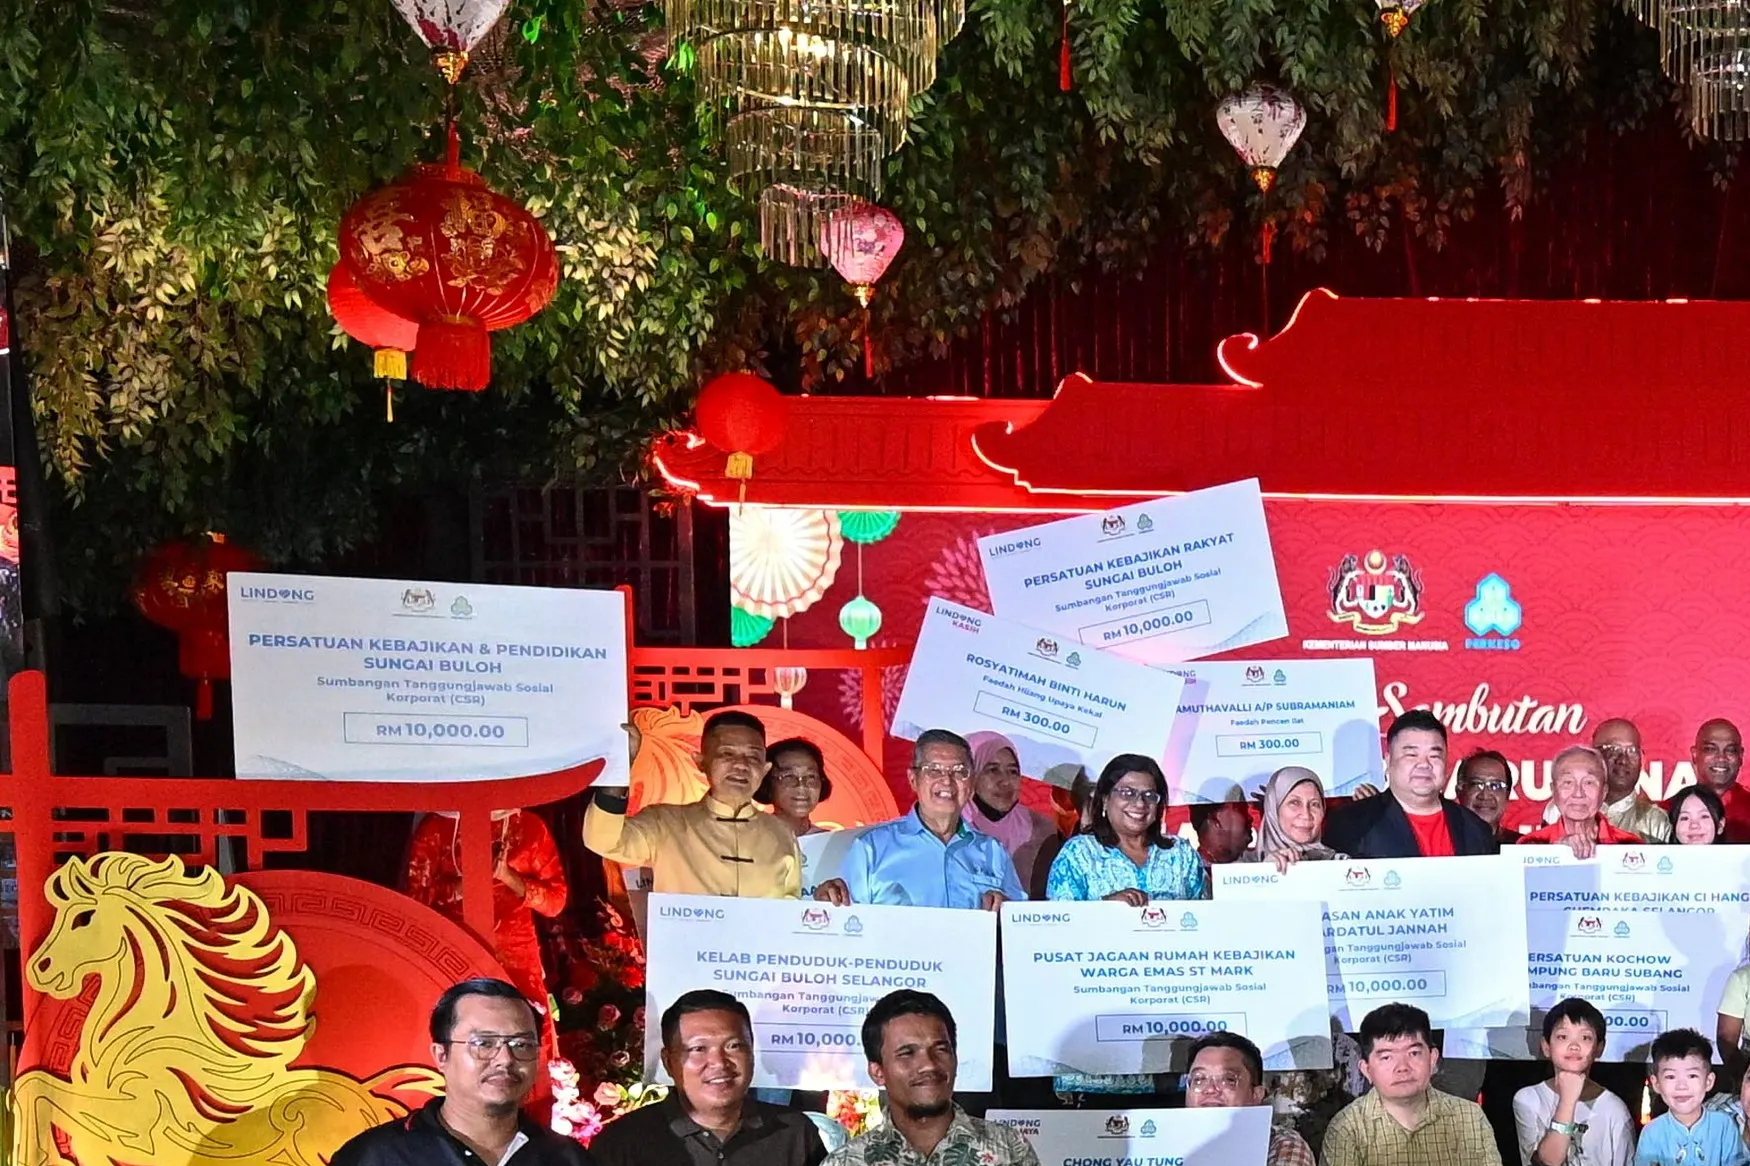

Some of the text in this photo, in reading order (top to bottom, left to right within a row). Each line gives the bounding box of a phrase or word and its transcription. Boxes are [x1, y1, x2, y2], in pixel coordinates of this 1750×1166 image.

[1024, 533, 1235, 588] PERSATUAN KEBAJIKAN RAKYAT
[1084, 560, 1183, 590] SUNGAI BULOH
[1103, 611, 1193, 641] RM 10,000.00
[249, 634, 607, 660] PERSATUAN KEBAJIKAN & PENDIDIKAN
[364, 656, 502, 674] SUNGAI BULOH
[317, 676, 553, 693] Sumbangan Tanggungjawab Sosial
[966, 653, 1126, 711] ROSYATIMAH BINTI HARUN
[386, 692, 485, 707] Korporat (CSR)
[1255, 700, 1355, 712] A/P SUBRAMANIAM
[1002, 706, 1070, 734] RM 300.00
[376, 723, 504, 739] RM 10,000.00
[1240, 739, 1299, 750] RM 300.00
[1530, 892, 1750, 902] PERSATUAN KEBAJIKAN CI HANG
[1365, 908, 1454, 920] ANAK YATIM
[1387, 923, 1448, 935] JANNAH
[1347, 941, 1433, 953] Tanggungjawab
[1436, 939, 1467, 949] Sosial
[696, 951, 943, 973] KELAB PENDUDUK-PENDUDUK
[1034, 949, 1295, 963] PUSAT JAGAAN RUMAH KEBAJIKAN
[1383, 954, 1412, 964] (CSR)
[1606, 954, 1671, 965] KOCHOW
[713, 969, 927, 988] SUNGAI BULOH SELANGOR
[1080, 965, 1253, 978] WARGA EMAS ST MARK
[1582, 967, 1683, 978] BARU SUBANG
[1074, 982, 1266, 995] Sumbangan Tanggungjawab Sosial
[1348, 978, 1427, 993] 10,000.00
[1660, 984, 1690, 993] Sosial
[1130, 995, 1211, 1006] Korporat (CSR)
[782, 1004, 835, 1016] Korporat
[1123, 1020, 1228, 1036] RM 10,000.00
[771, 1034, 795, 1046] RM
[1147, 1157, 1184, 1166] TUNG
